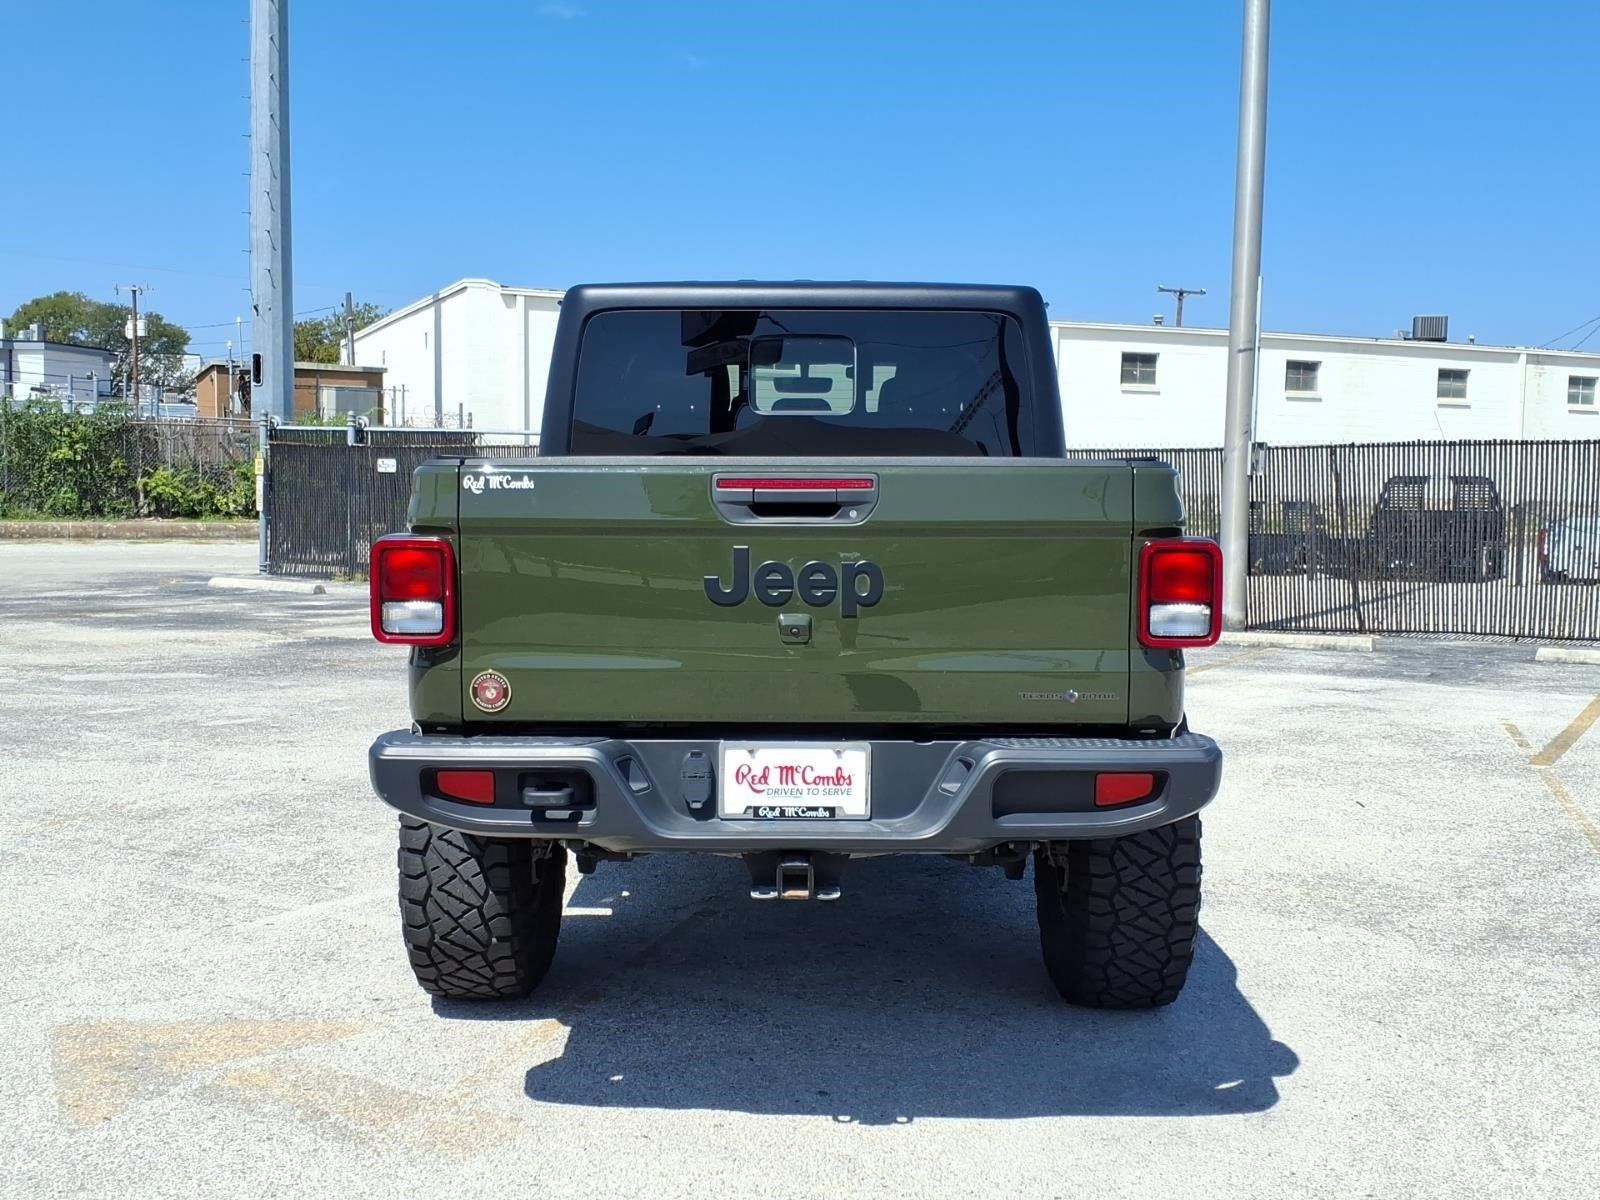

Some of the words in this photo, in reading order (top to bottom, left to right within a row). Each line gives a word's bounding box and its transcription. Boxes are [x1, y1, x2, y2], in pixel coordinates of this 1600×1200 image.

[463, 474, 485, 494] Red
[703, 545, 884, 618] Jeep
[735, 763, 770, 794] Red
[773, 764, 853, 787] McCombs
[766, 787, 804, 797] DRIVEN
[806, 787, 820, 797] TO
[822, 787, 853, 797] SERVE
[758, 806, 781, 818] Red
[781, 806, 830, 818] McCombs
